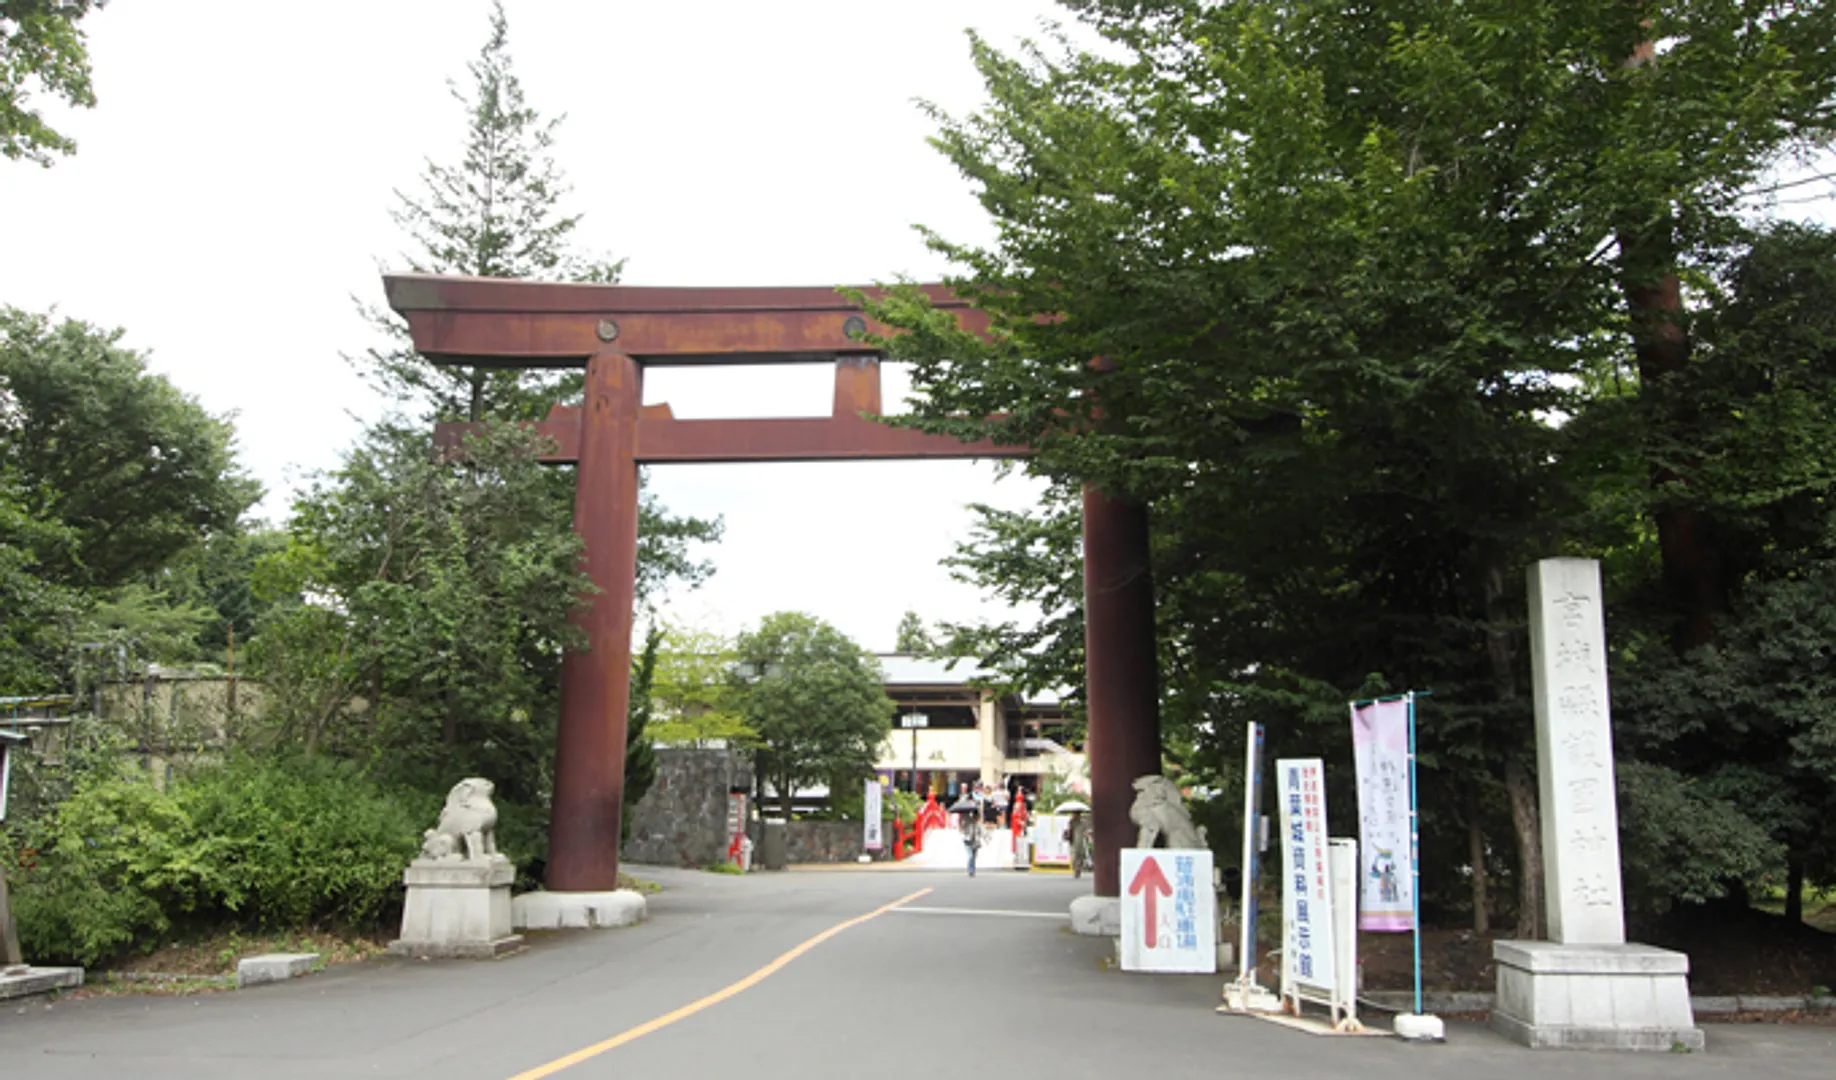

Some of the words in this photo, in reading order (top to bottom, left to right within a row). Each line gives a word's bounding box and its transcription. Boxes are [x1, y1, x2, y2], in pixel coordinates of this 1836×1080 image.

[1287, 767, 1312, 977] 青葉城資料展示館
